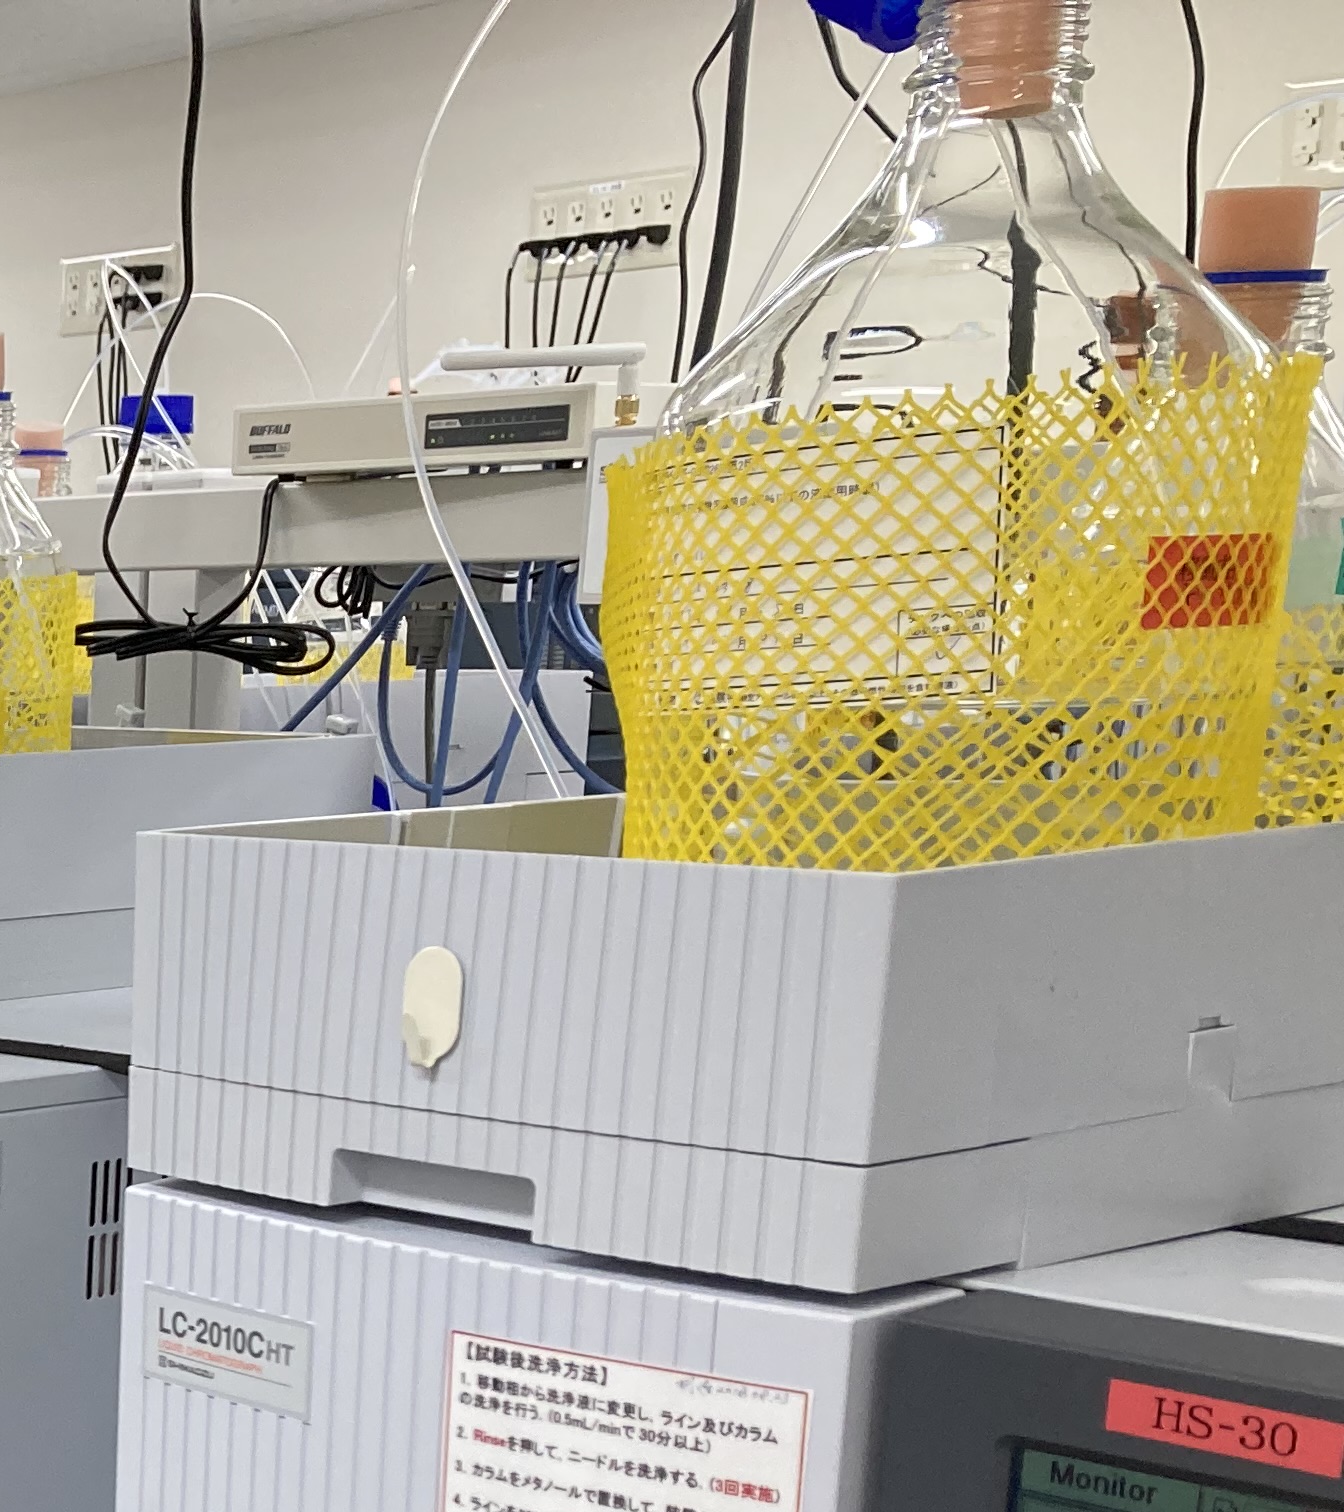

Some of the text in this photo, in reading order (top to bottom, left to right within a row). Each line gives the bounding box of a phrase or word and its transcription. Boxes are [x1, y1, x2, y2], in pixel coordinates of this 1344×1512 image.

[158, 1307, 295, 1367] LC-2010CHT
[1151, 1396, 1300, 1458] HS-30
[1050, 1460, 1159, 1505] Monitor
